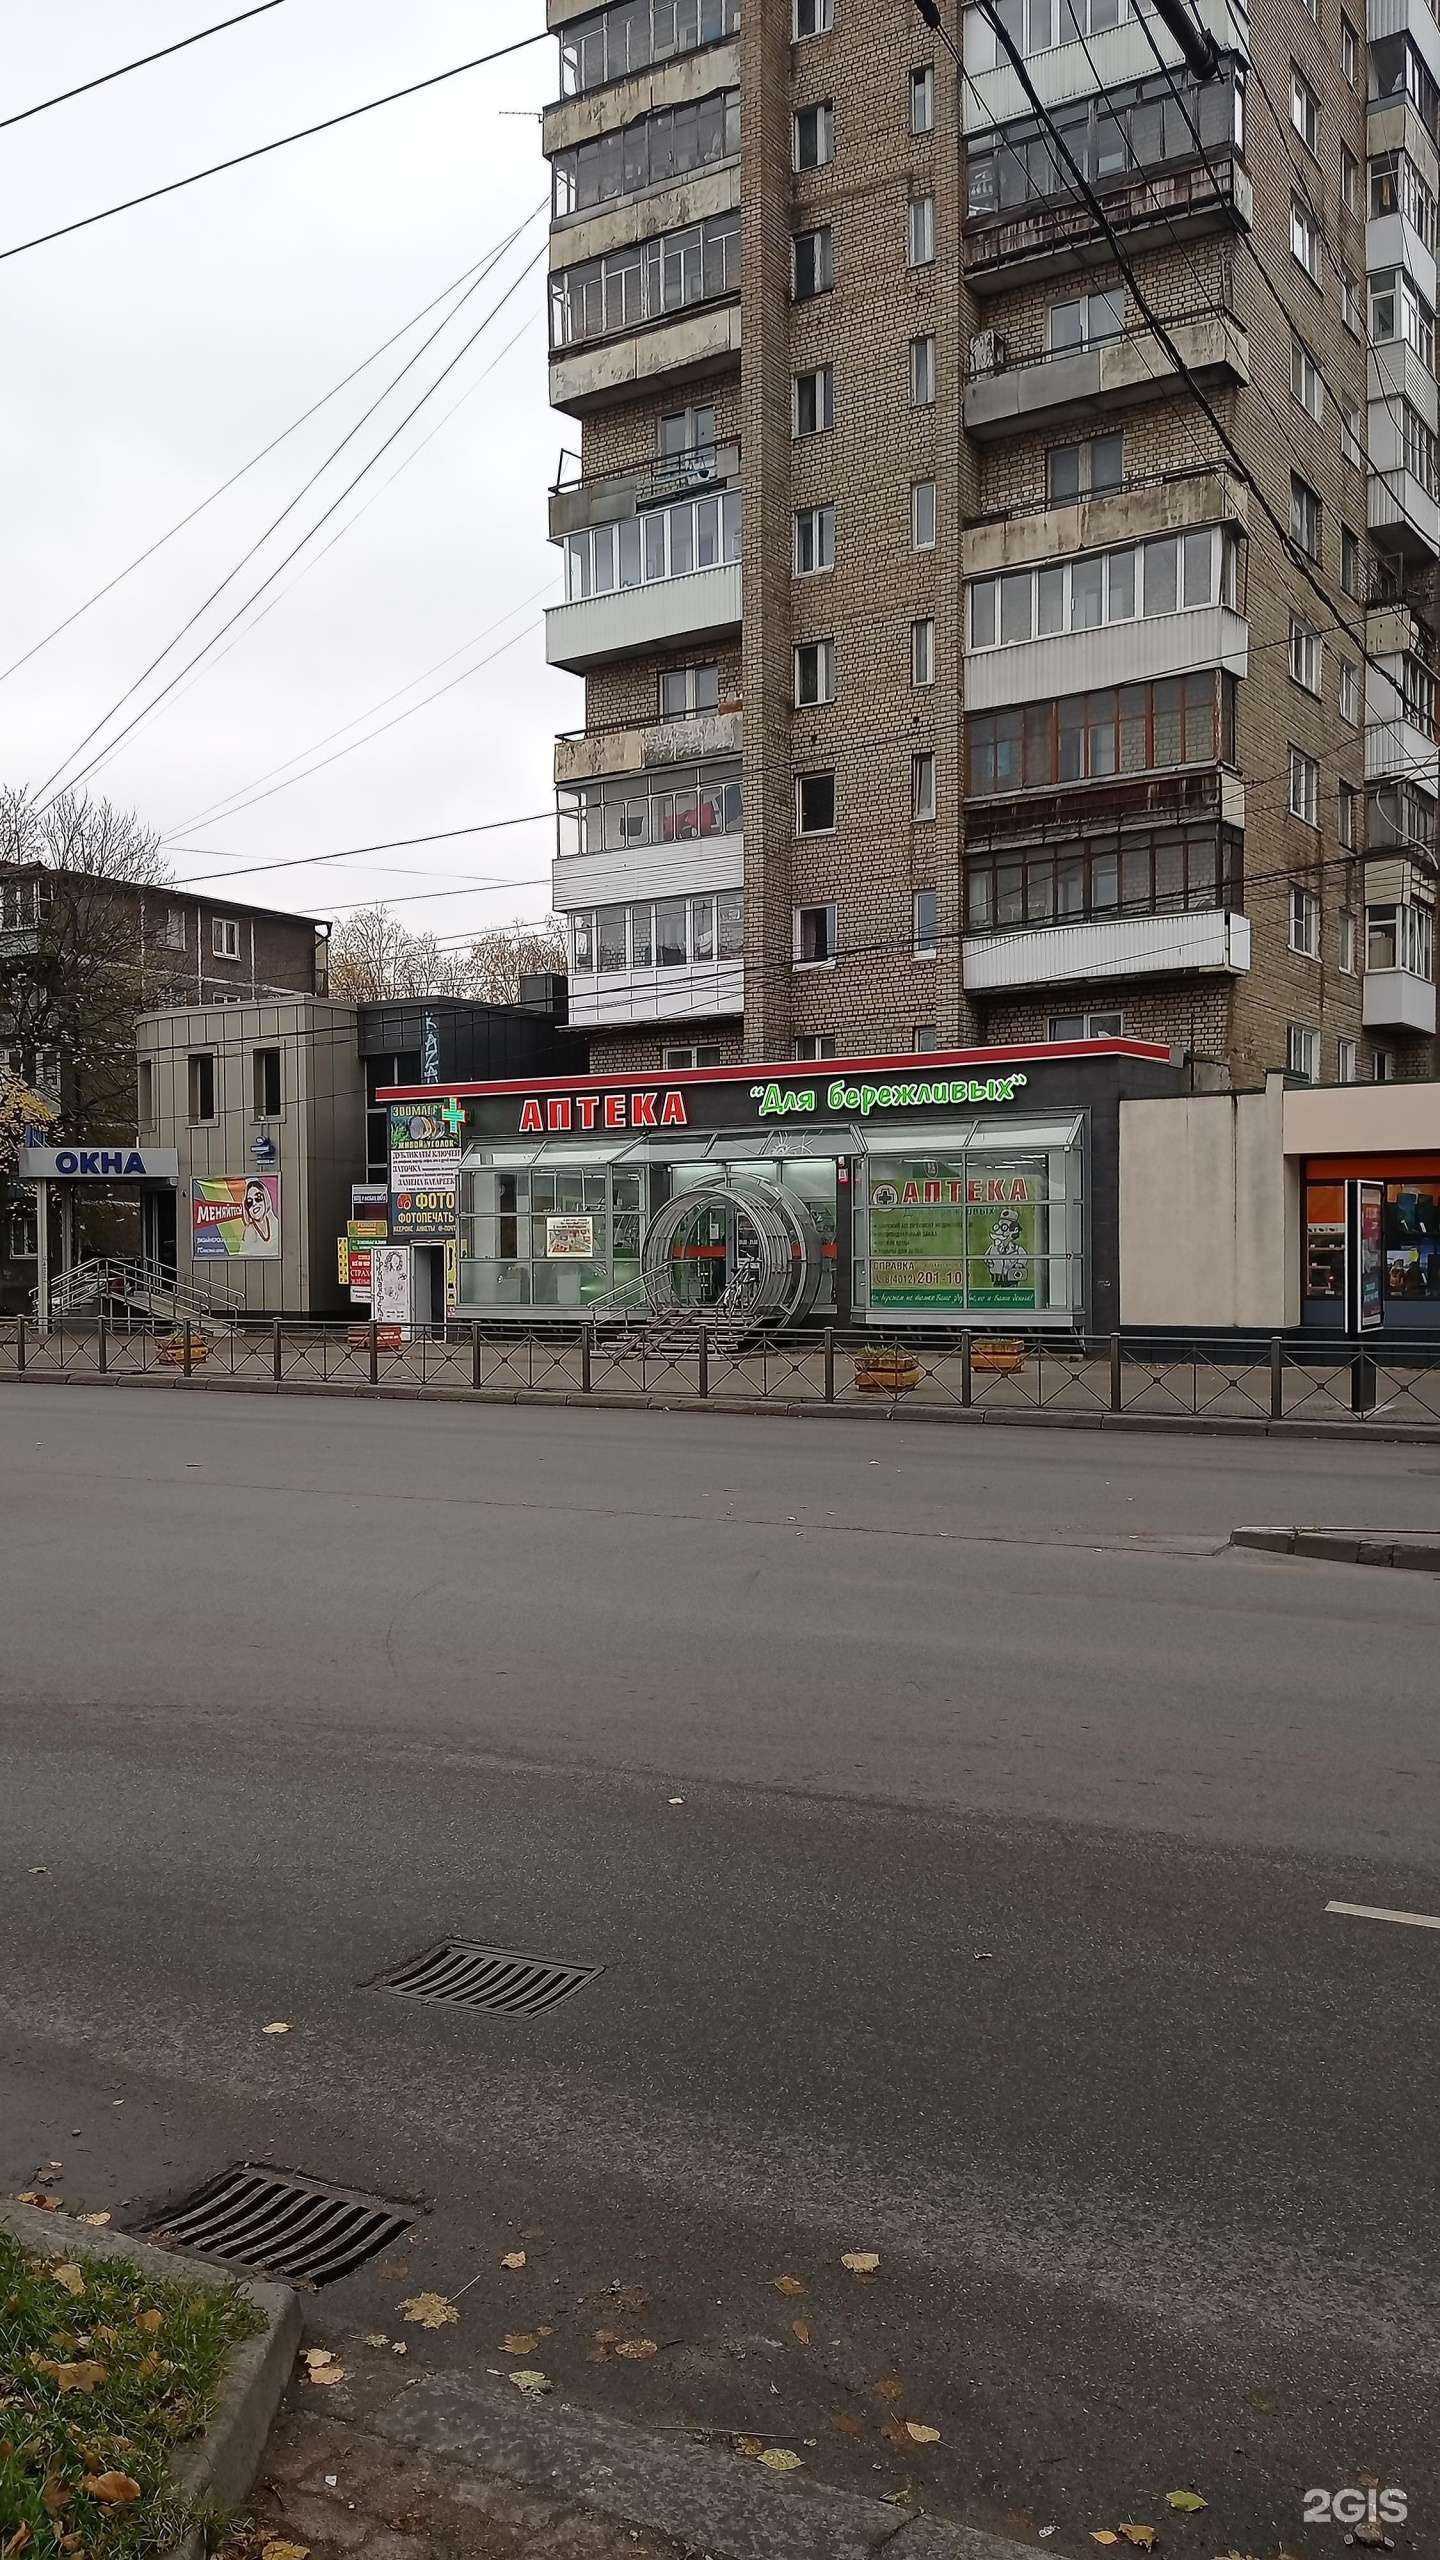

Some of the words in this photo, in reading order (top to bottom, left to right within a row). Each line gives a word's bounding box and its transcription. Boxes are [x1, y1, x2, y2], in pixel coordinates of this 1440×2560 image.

[519, 1091, 687, 1132] АПТЕКА
[55, 1151, 147, 1174] ОКНА
[416, 1193, 455, 1209] ФОТО
[901, 1177, 1029, 1203] АПТЕКА
[398, 1211, 455, 1223] ФОТОПЕЧАТЬ
